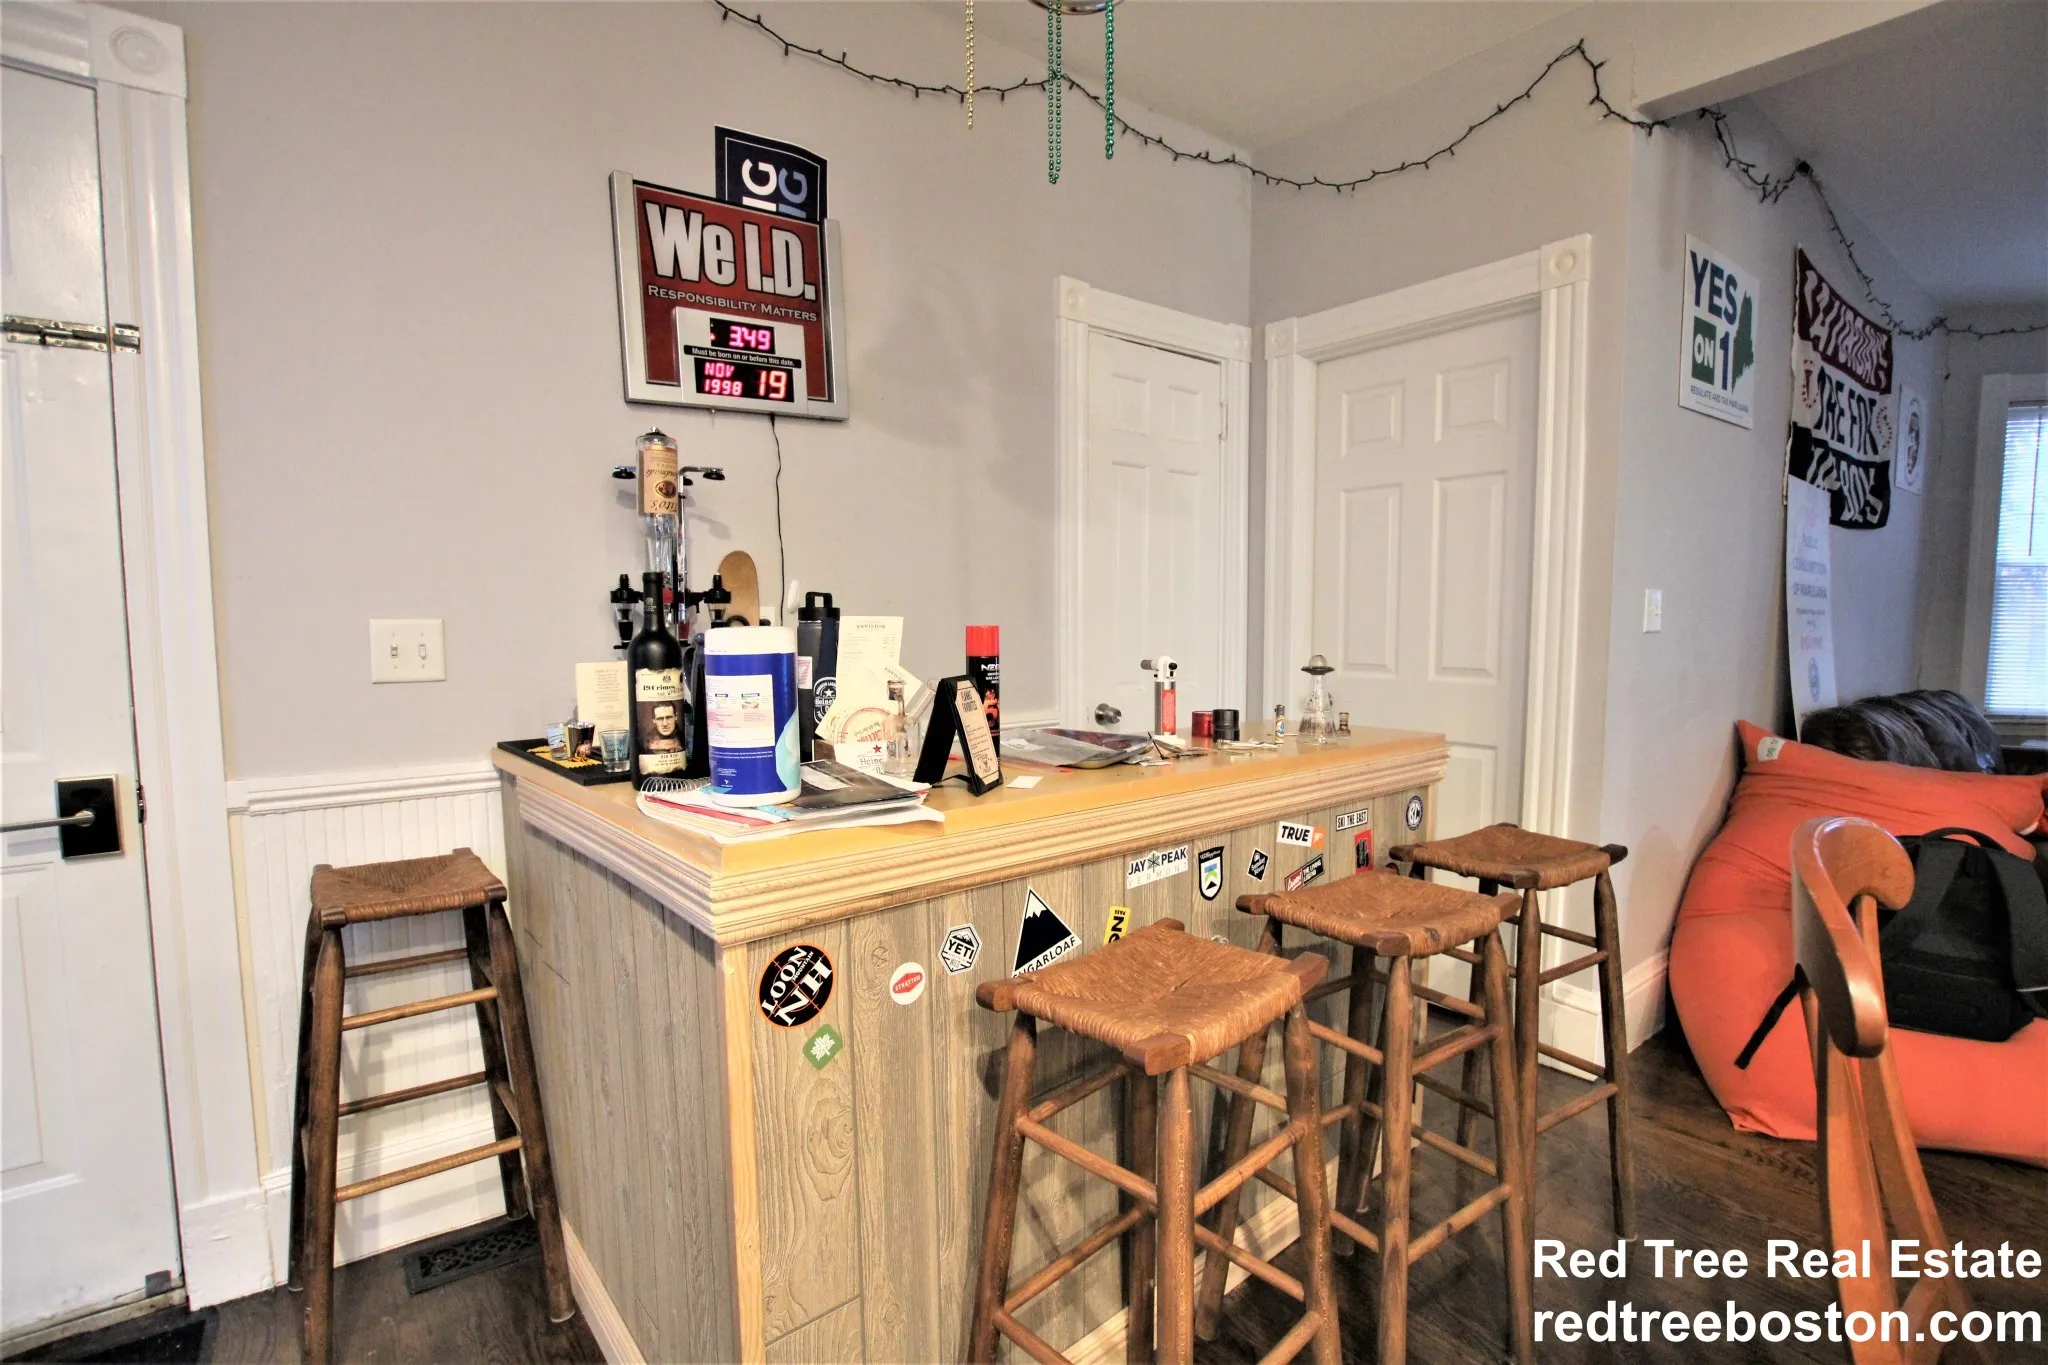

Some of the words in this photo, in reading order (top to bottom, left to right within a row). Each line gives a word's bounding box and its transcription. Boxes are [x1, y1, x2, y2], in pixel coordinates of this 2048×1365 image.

[644, 202, 736, 287] We
[743, 221, 818, 301] I.D.
[1689, 249, 1738, 325] YES
[647, 285, 757, 312] RESPONSIBILITY
[761, 303, 817, 322] MATTERS
[692, 348, 708, 356] Must
[781, 359, 795, 367] date.
[704, 362, 735, 378] NOV
[1694, 333, 1714, 369] ON
[1719, 331, 1730, 391] 1
[704, 378, 743, 396] 1998
[759, 369, 788, 399] 19
[815, 698, 834, 706] Heine
[860, 758, 884, 766] Heine
[1337, 816, 1345, 828] SKI
[1347, 814, 1355, 826] THE
[1356, 811, 1367, 824] EAST
[1281, 825, 1311, 842] TRUE
[1128, 859, 1147, 876] JAY
[1161, 847, 1187, 866] PEAK
[1128, 862, 1188, 887] VERMONT
[948, 939, 975, 960] YETI
[793, 950, 815, 982] MOUNTAIN
[761, 946, 809, 1014] LOON
[774, 959, 833, 1027] NH
[894, 975, 921, 992] STRATTON
